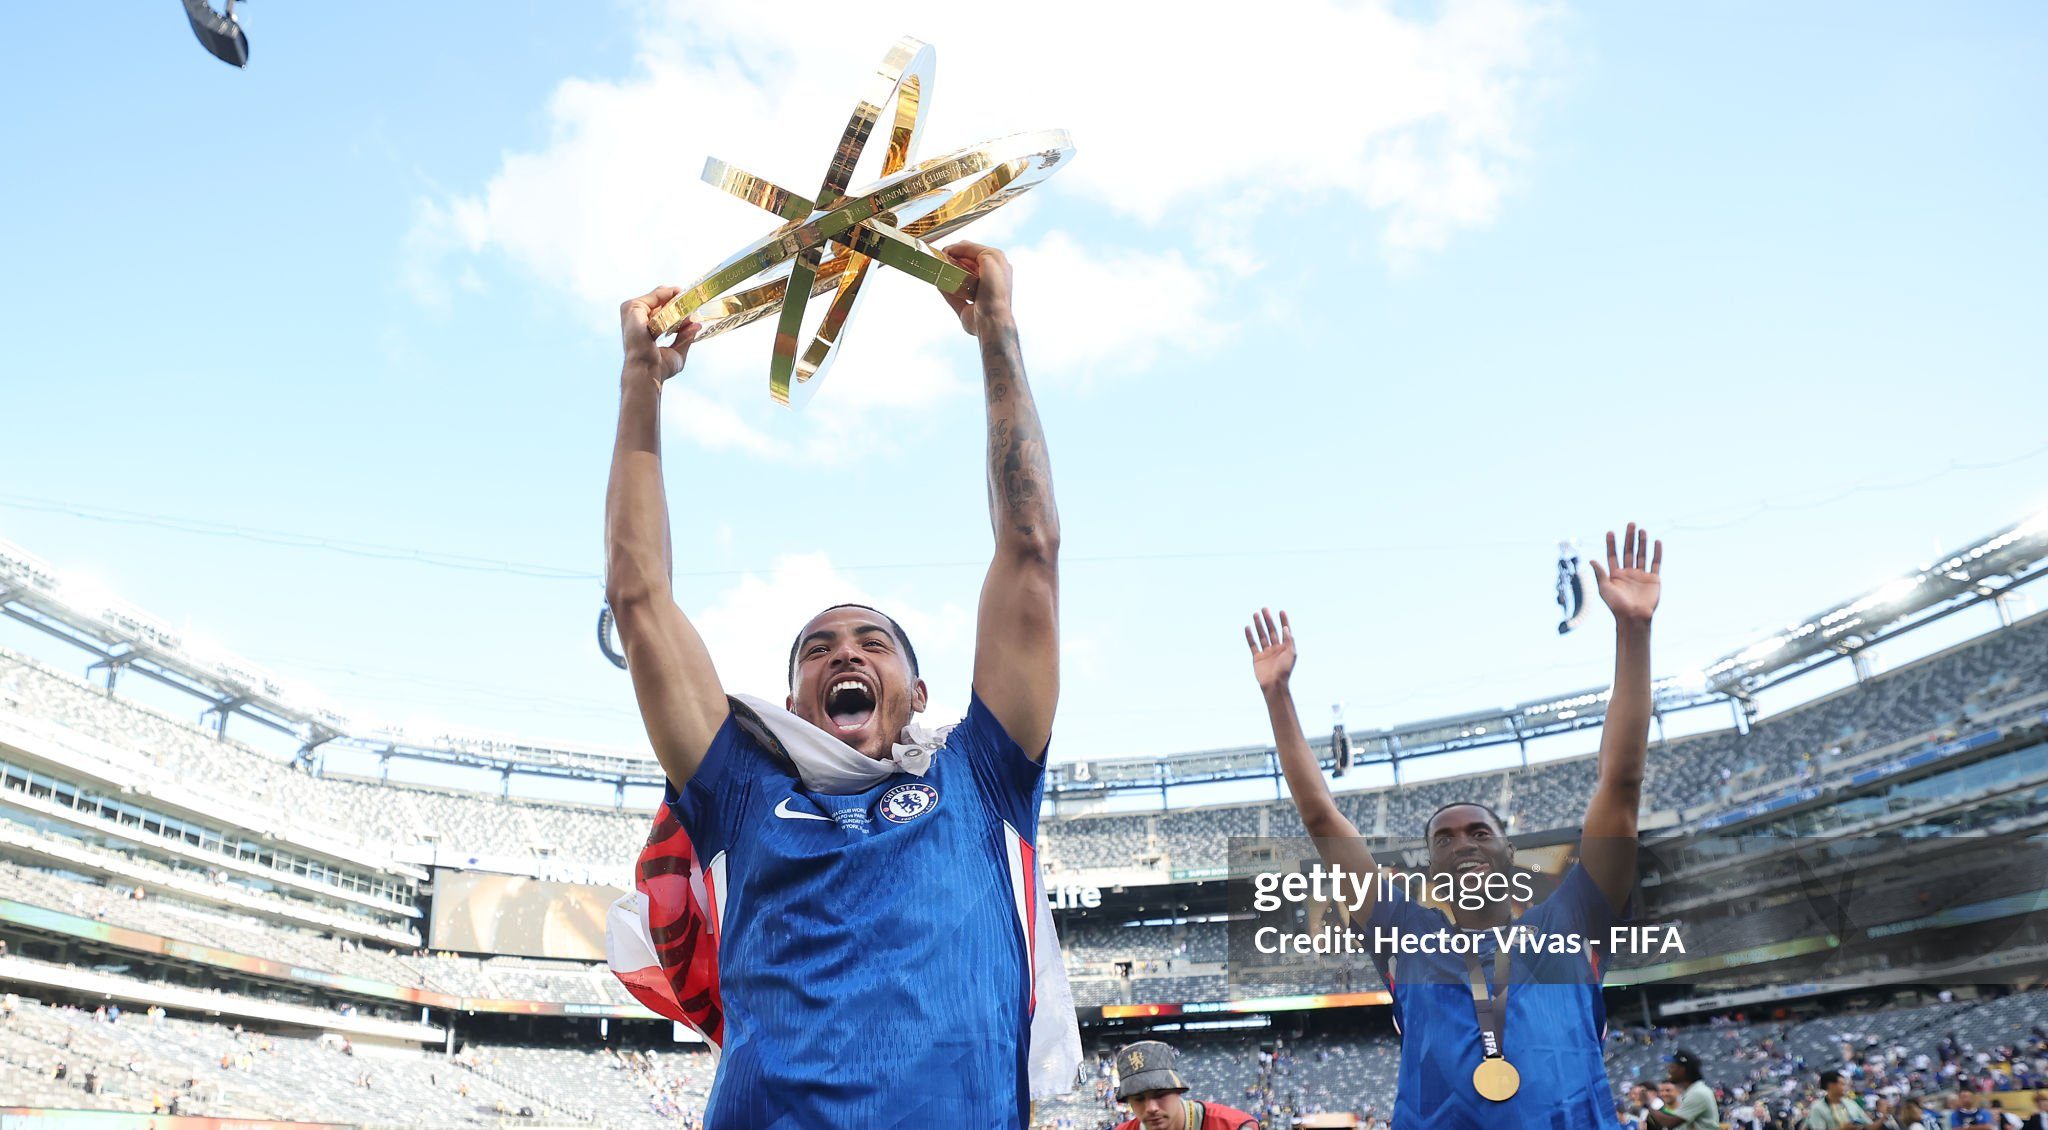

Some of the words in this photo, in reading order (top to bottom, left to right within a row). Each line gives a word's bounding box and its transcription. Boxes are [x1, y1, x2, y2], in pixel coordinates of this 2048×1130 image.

[875, 184, 911, 206] MUNDIAL
[926, 167, 951, 185] CLUBES
[883, 786, 917, 803] CHELSEA
[1483, 1031, 1498, 1056] FIFA
